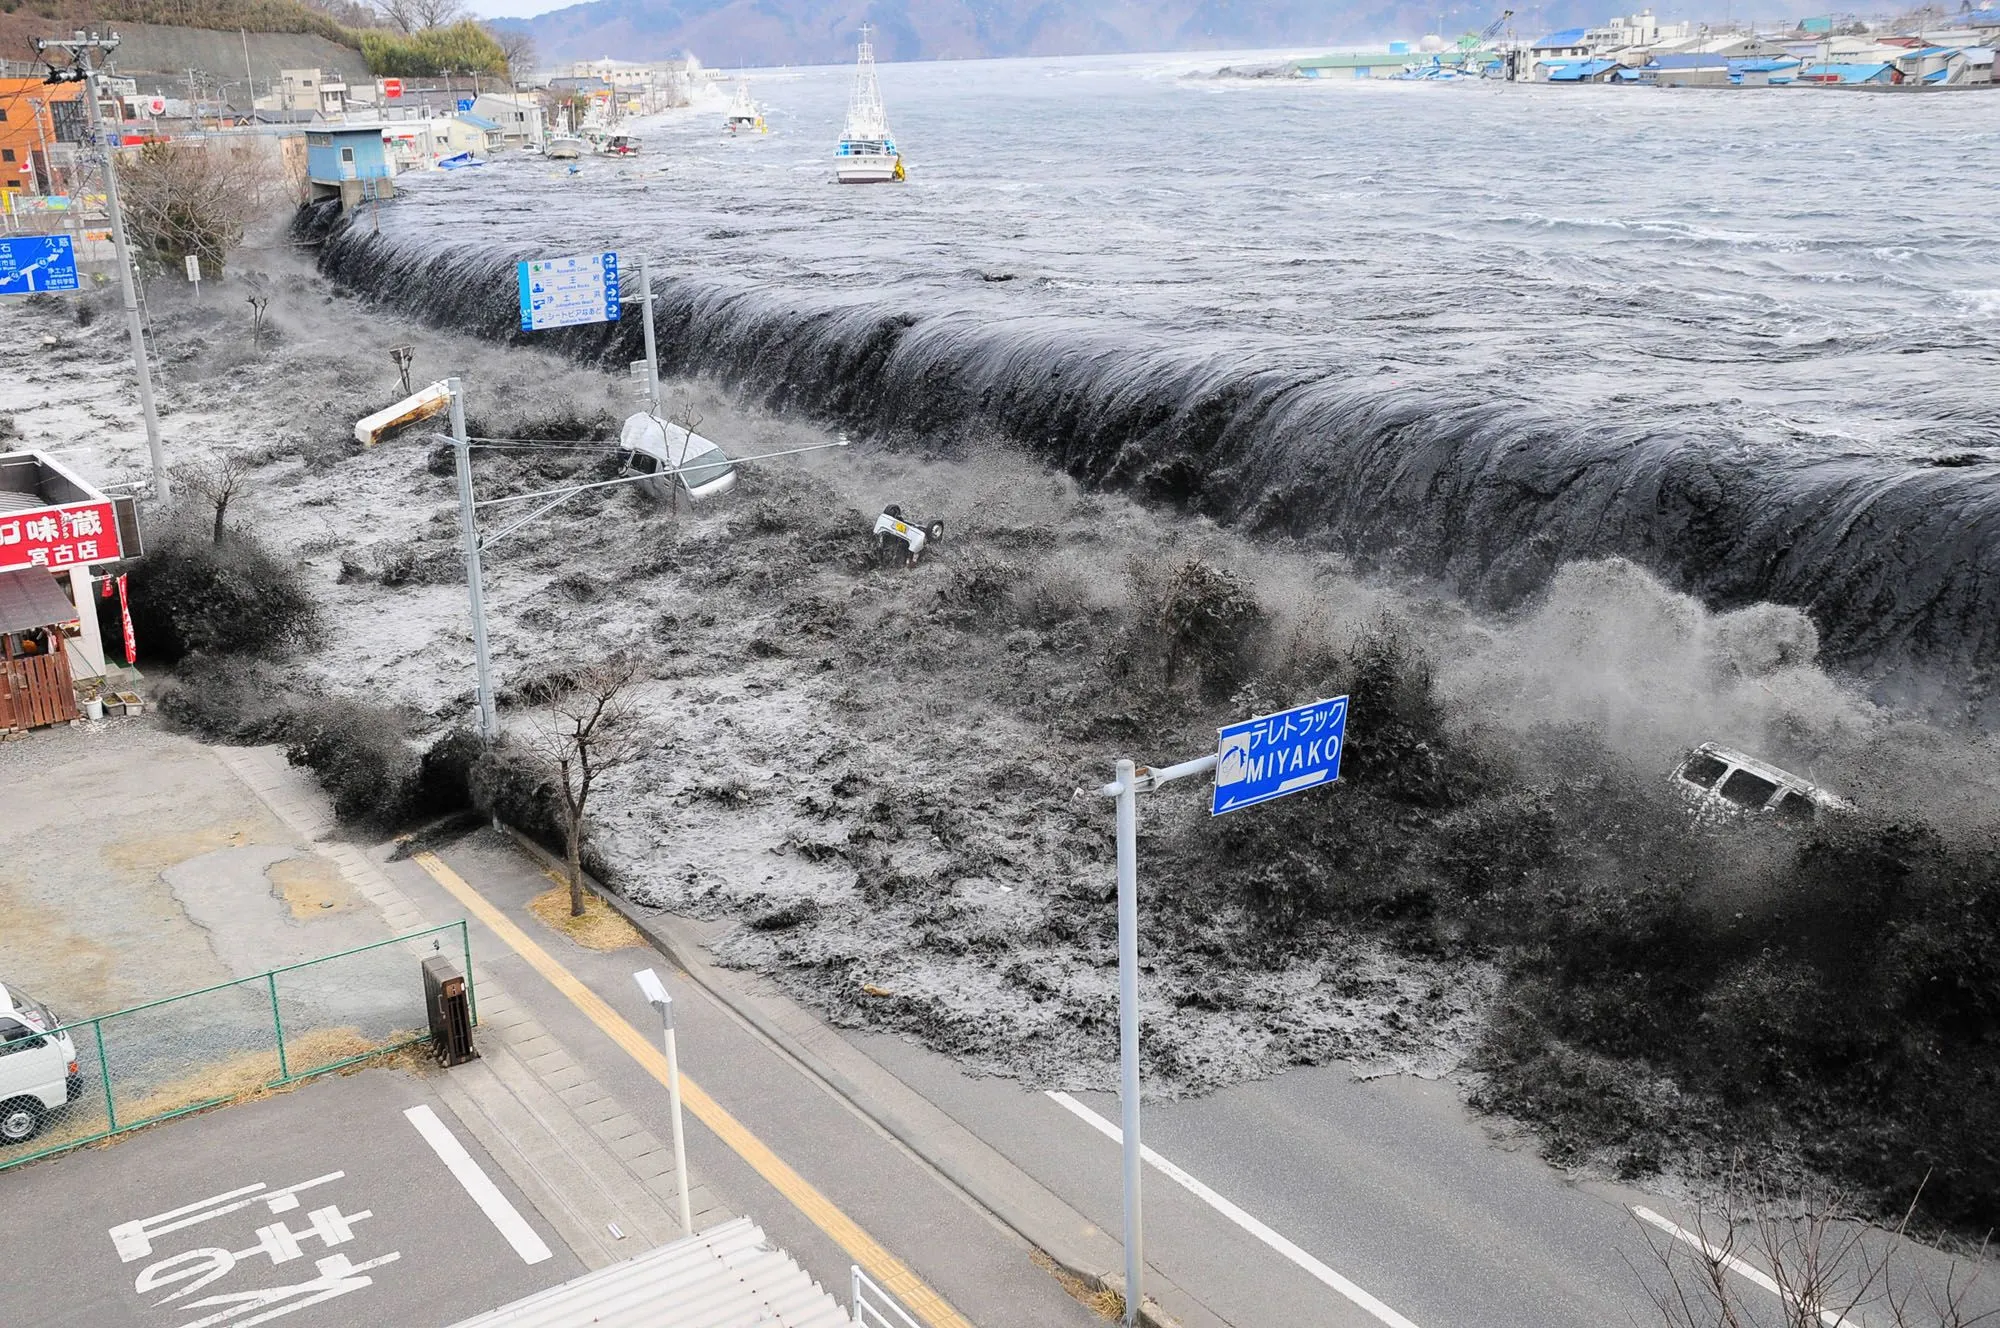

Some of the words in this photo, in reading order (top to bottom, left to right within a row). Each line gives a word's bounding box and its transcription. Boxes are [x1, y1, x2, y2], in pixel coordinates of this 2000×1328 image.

[27, 540, 99, 566] 宮古店
[1251, 701, 1345, 750] テレトラック
[1246, 735, 1339, 785] MIYAKO
